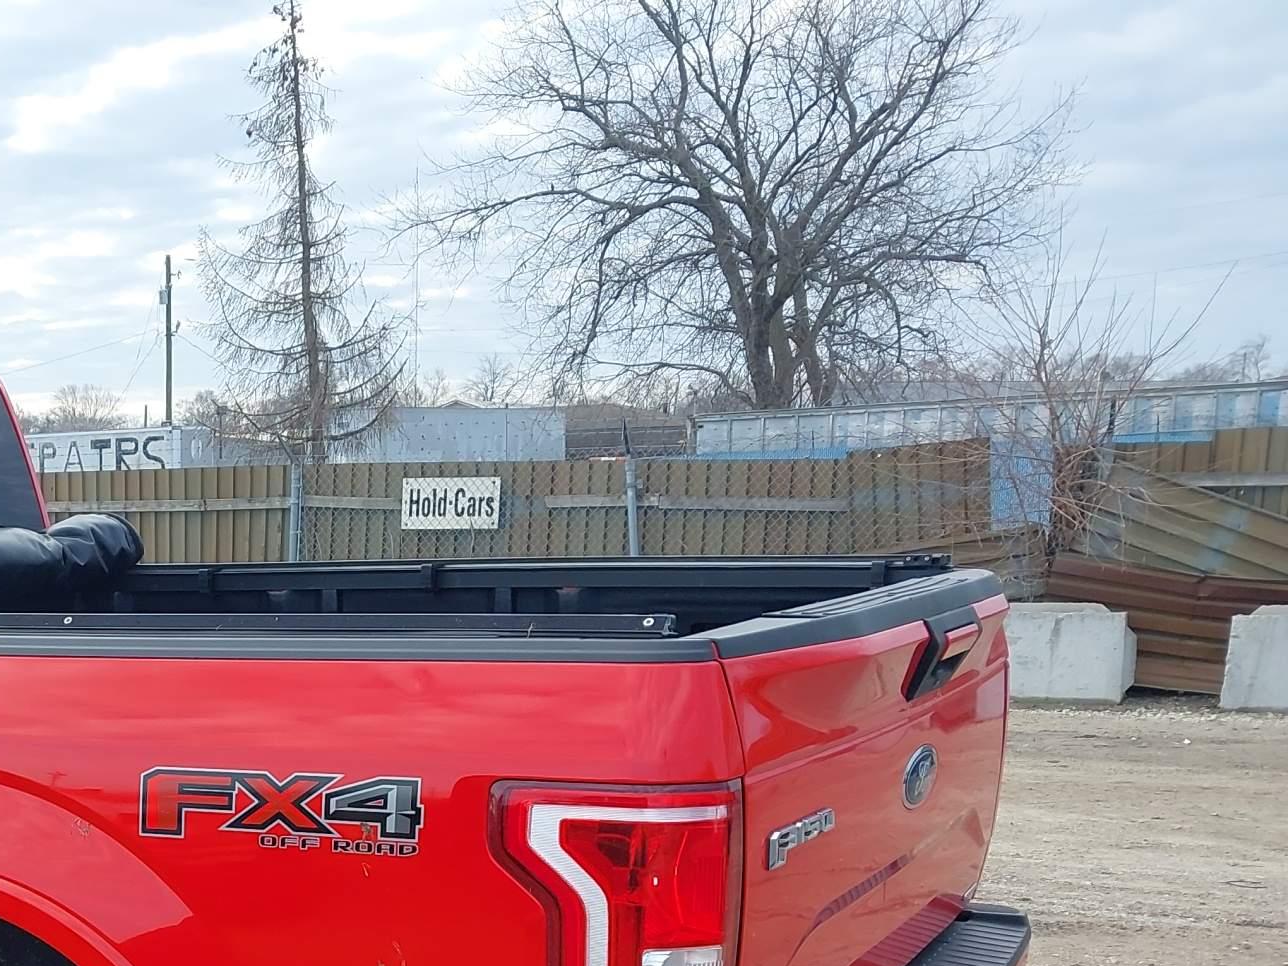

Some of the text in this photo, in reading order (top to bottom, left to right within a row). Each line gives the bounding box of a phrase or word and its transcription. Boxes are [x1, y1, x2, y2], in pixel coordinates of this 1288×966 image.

[31, 436, 165, 472] PATRS
[139, 766, 424, 842] FX4
[259, 834, 419, 857] OFF ROAD
